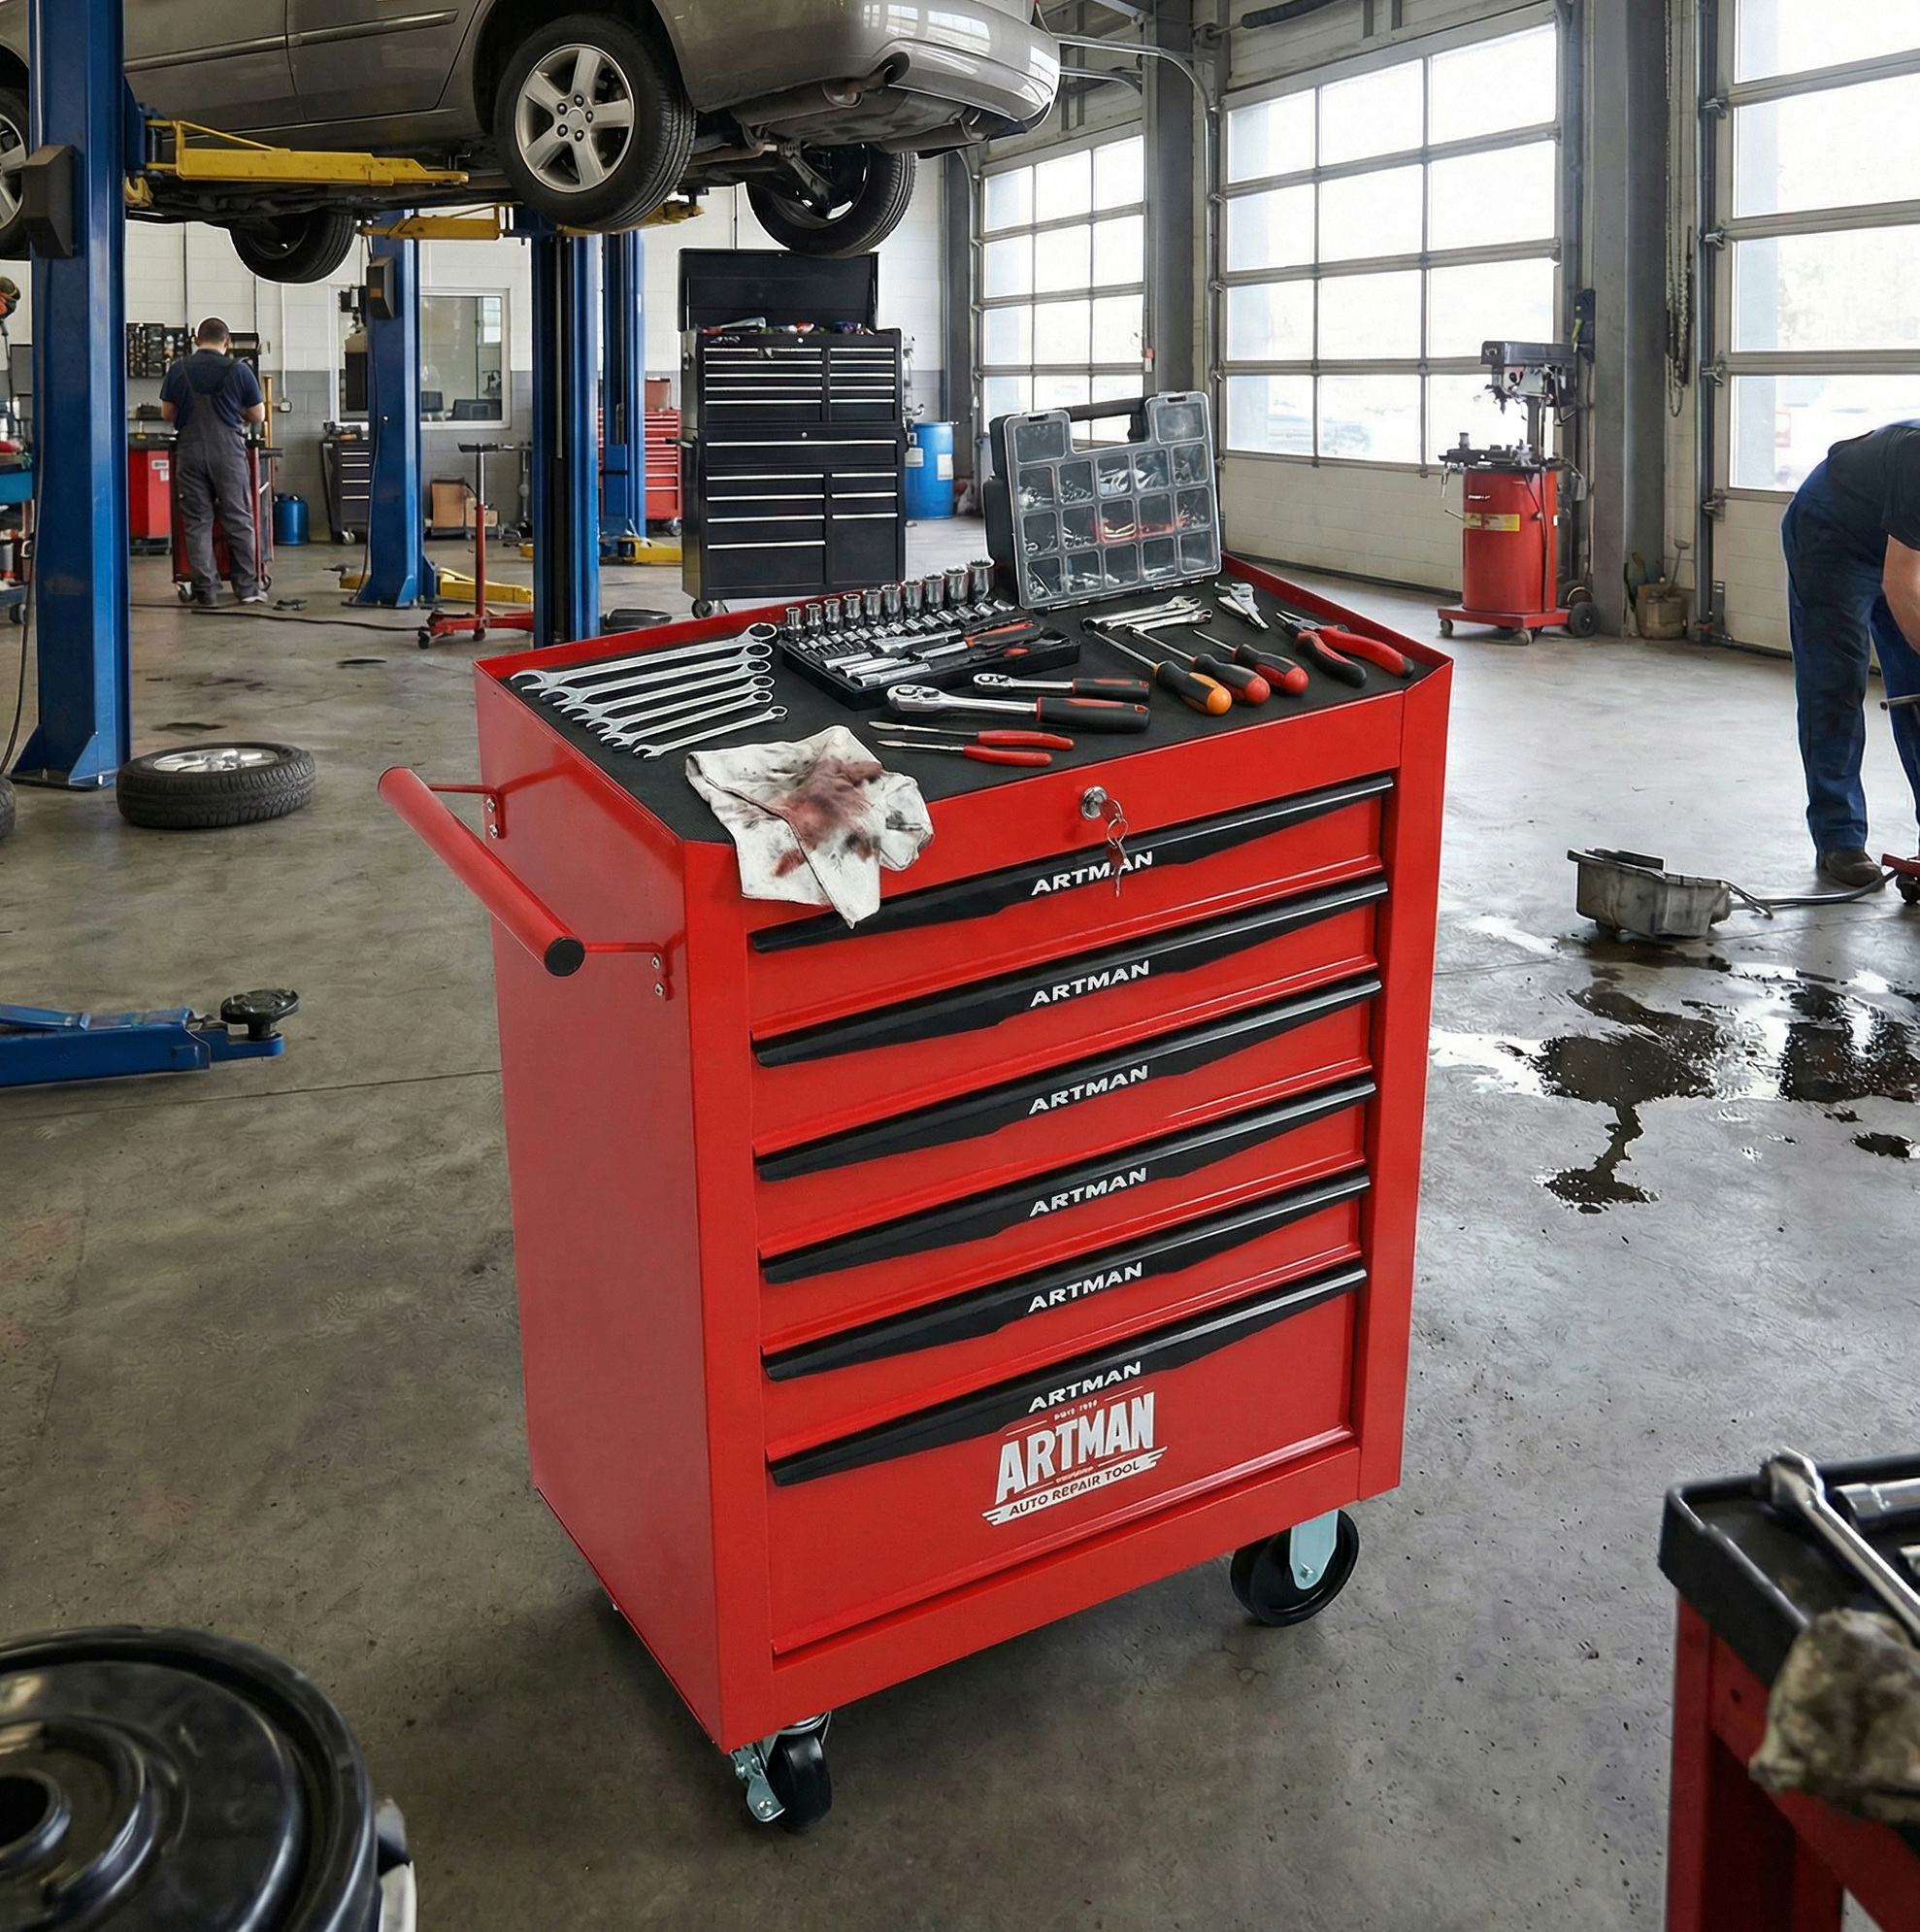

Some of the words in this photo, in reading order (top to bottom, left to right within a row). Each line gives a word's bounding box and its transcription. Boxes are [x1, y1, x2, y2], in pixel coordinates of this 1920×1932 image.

[1031, 851, 1153, 896] ARTMAN
[1030, 960, 1149, 1008] ARTMAN
[1028, 1065, 1148, 1115] ARTMAN
[1029, 1167, 1147, 1217] ARTMAN
[1027, 1261, 1142, 1313] ARTMAN
[1028, 1361, 1142, 1414] ARTMAN
[995, 1391, 1155, 1506] ARTMAN
[1009, 1494, 1048, 1516] AUTO
[1052, 1475, 1101, 1501] REPAIR
[1105, 1460, 1141, 1481] TOOL
